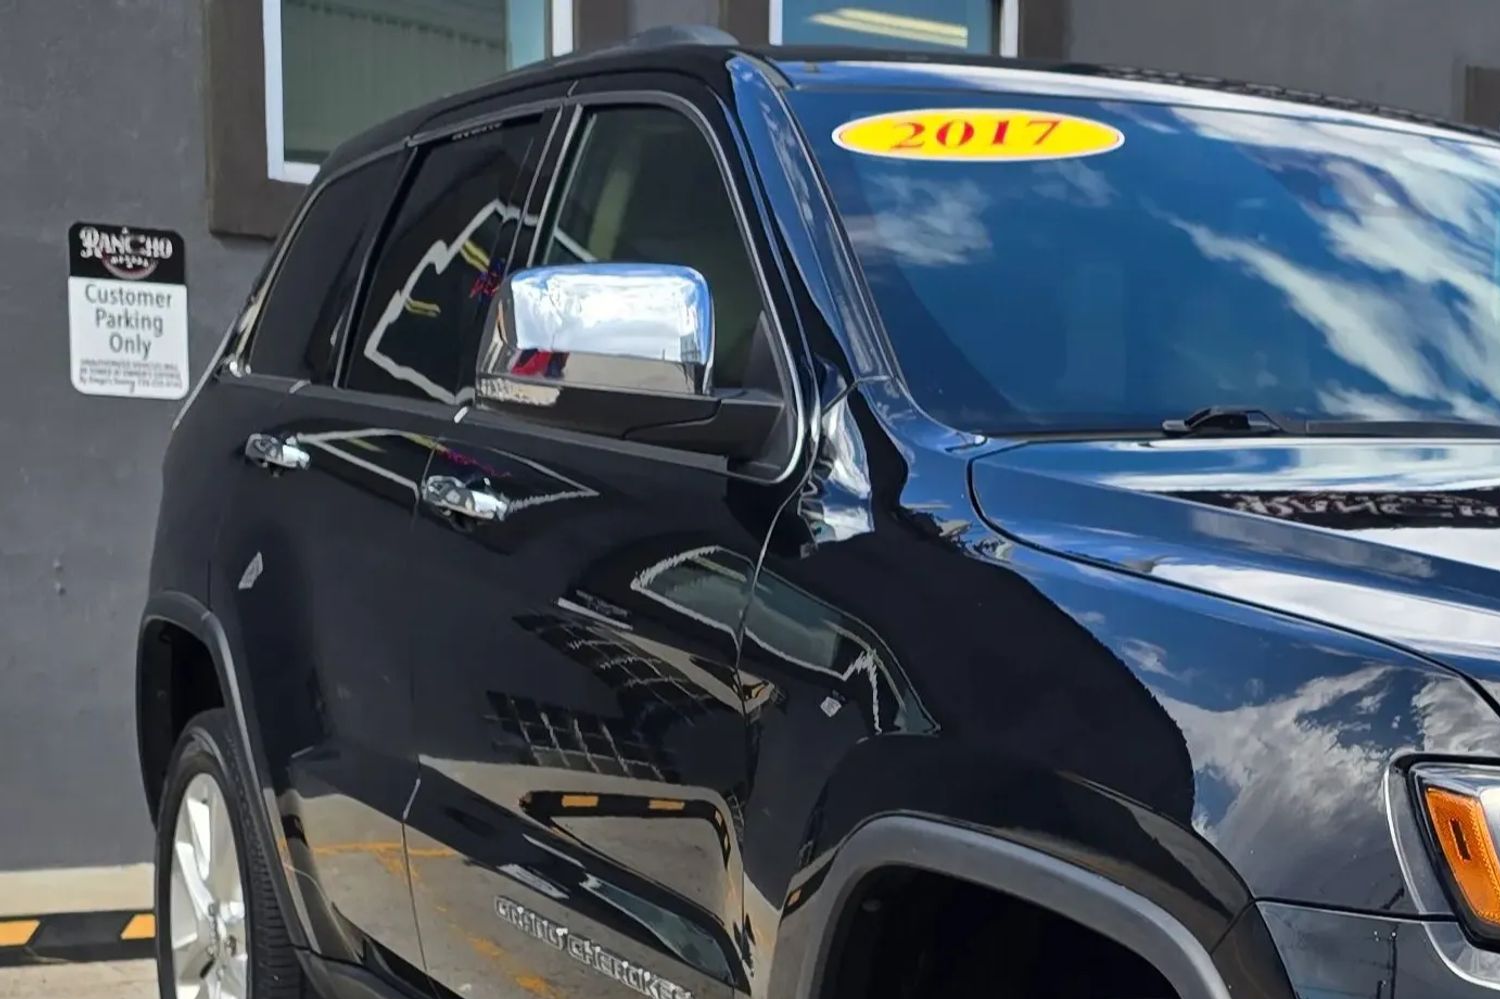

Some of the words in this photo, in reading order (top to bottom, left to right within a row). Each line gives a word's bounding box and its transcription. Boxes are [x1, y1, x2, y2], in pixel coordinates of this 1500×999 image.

[890, 119, 1061, 149] 2017
[79, 226, 172, 259] RANCHO
[85, 283, 172, 307] Customer
[95, 308, 163, 337] Parking
[109, 332, 152, 360] Only
